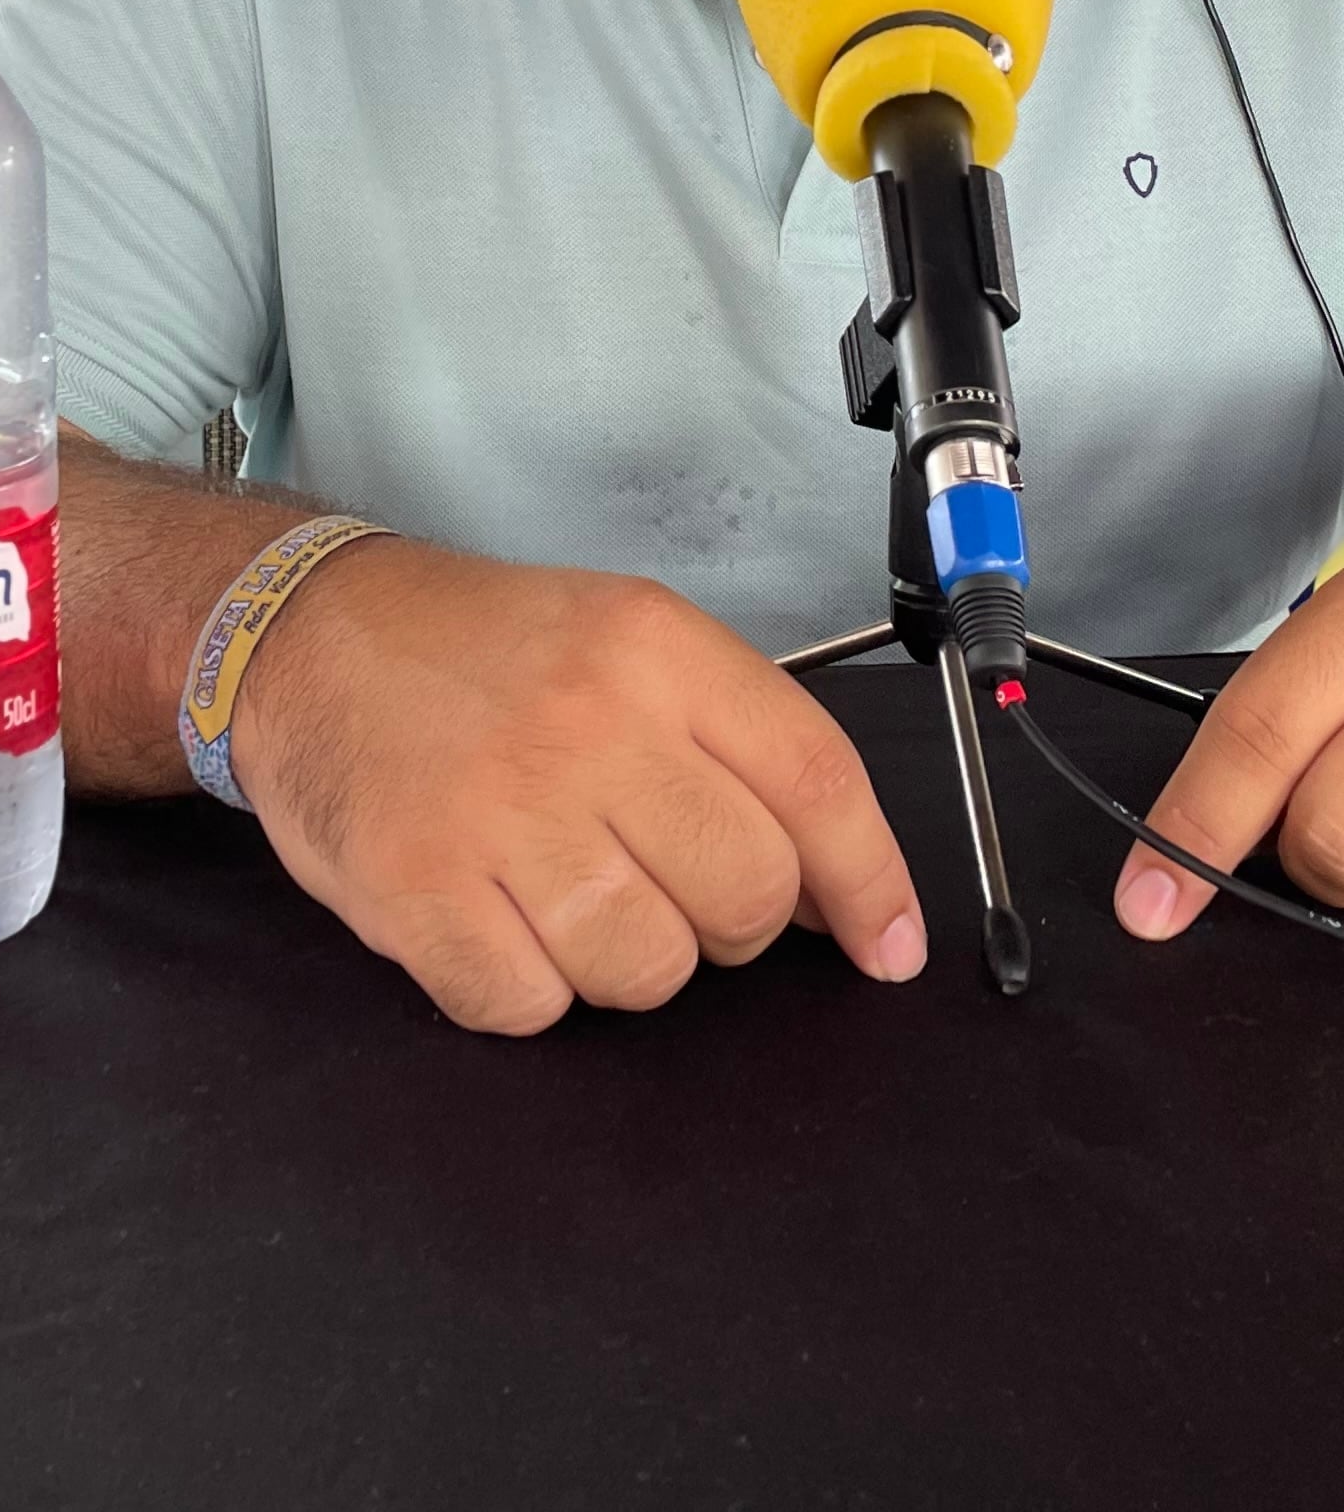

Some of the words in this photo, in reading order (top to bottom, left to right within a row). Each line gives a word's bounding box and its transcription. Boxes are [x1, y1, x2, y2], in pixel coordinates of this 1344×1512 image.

[945, 388, 996, 404] 21295
[194, 600, 254, 709] CASETA
[240, 565, 282, 595] LA
[3, 690, 37, 731] 50cl
